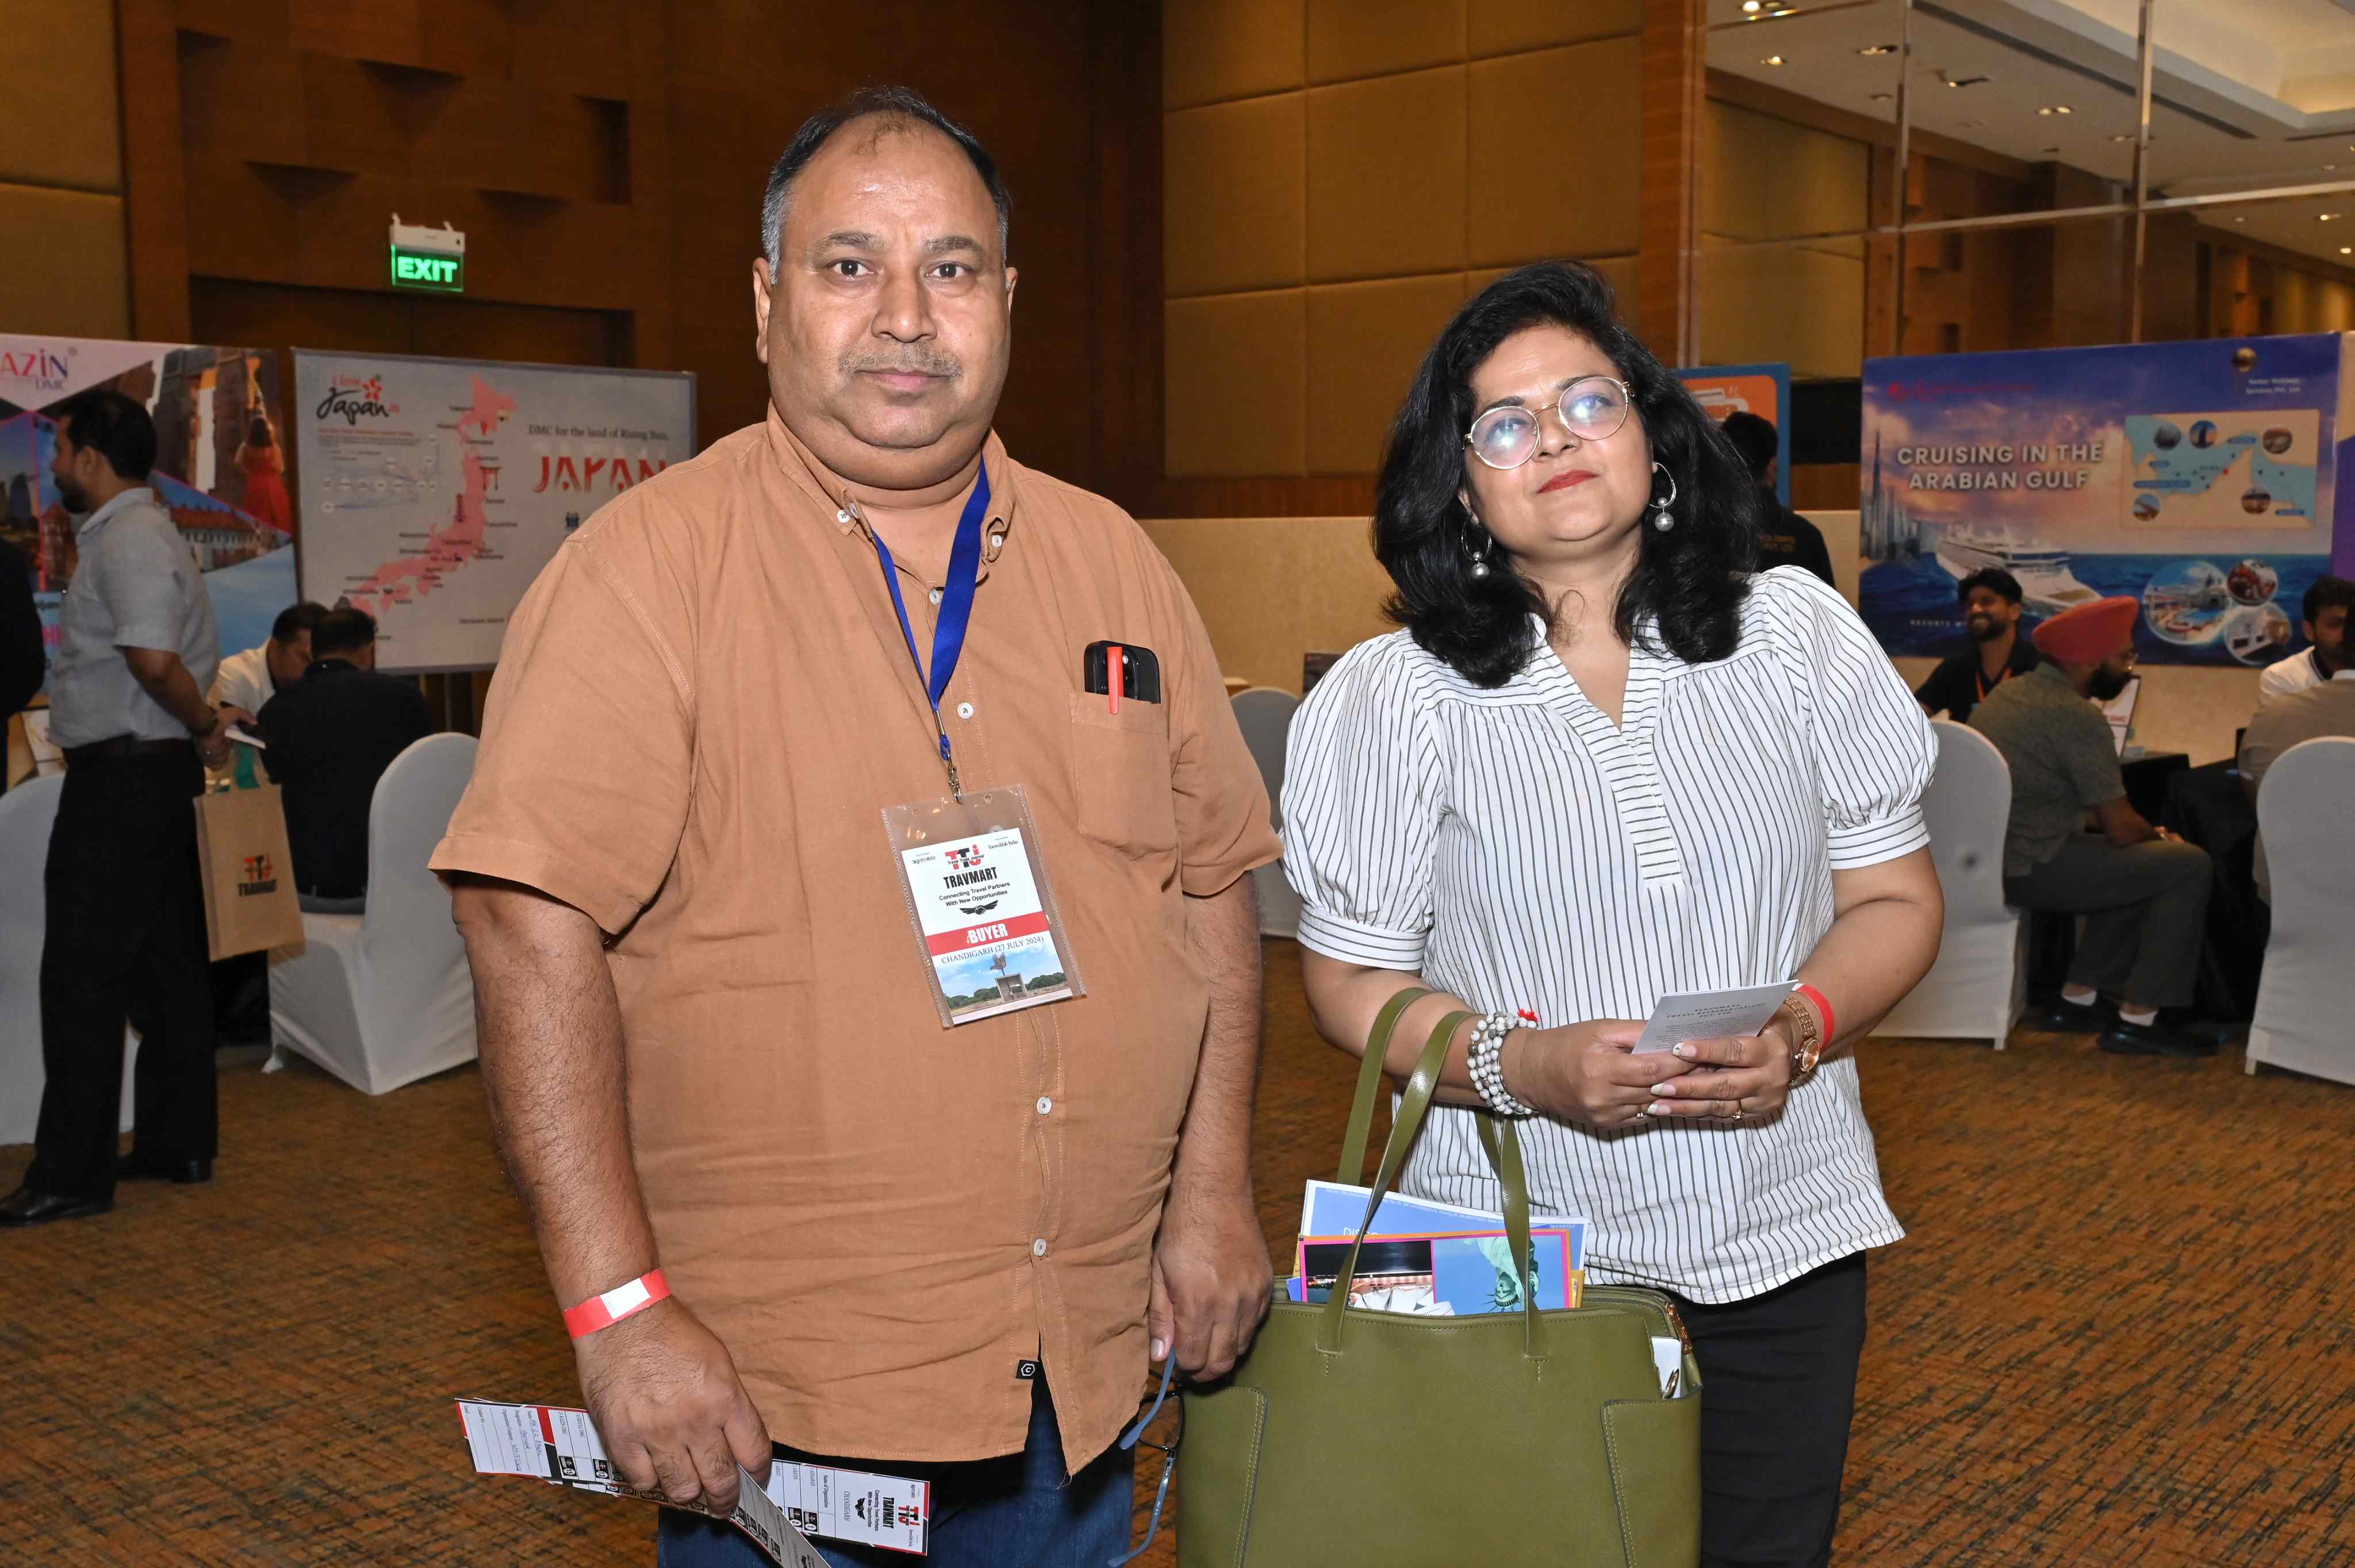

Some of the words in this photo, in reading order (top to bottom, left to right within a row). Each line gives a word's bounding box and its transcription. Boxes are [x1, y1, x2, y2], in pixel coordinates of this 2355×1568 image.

[397, 256, 458, 283] EXIT
[317, 386, 390, 426] Japan
[528, 424, 553, 435] DMC
[555, 425, 568, 436] for
[570, 426, 585, 437] the
[587, 426, 607, 438] land
[609, 428, 619, 439] of
[620, 428, 648, 441] Rising
[1897, 445, 2013, 465] CRUISING
[2023, 445, 2047, 463] IN
[2057, 443, 2104, 462] THE
[1909, 471, 2017, 490] ARABIAN
[2026, 470, 2089, 489] GULF
[943, 867, 998, 889] TRAVMART
[939, 890, 970, 901] Connecting
[971, 886, 987, 894] Travel
[988, 881, 1011, 890] Partners
[945, 899, 958, 907] With
[972, 890, 1008, 902] Opportunities
[966, 923, 1009, 944] BUYER
[941, 946, 994, 964] CHANDIGARH
[995, 943, 1005, 953] (27
[1007, 940, 1024, 950] JULY
[1026, 935, 1045, 946] 2024)
[883, 1497, 895, 1529] TRAVMART
